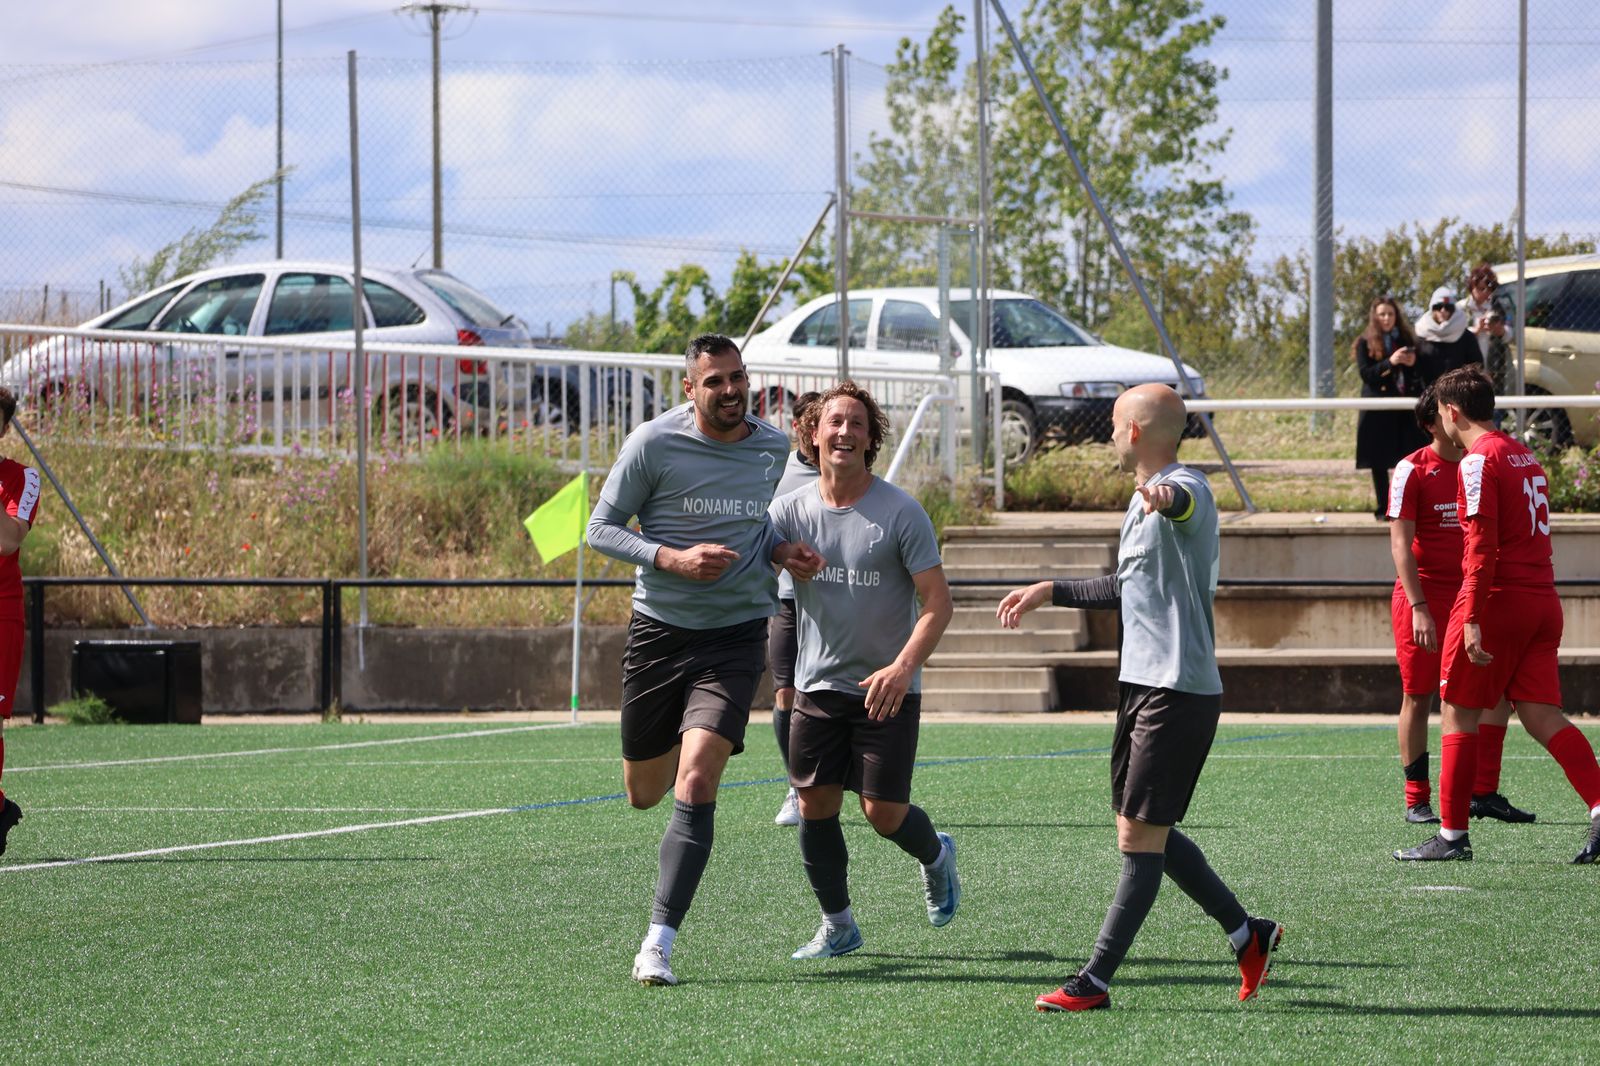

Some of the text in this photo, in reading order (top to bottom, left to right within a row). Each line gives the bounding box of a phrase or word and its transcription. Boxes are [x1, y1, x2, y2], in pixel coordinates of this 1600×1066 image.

[683, 497, 742, 516] NONAME
[1523, 476, 1550, 537] 15
[812, 566, 880, 587] AME CLUB
